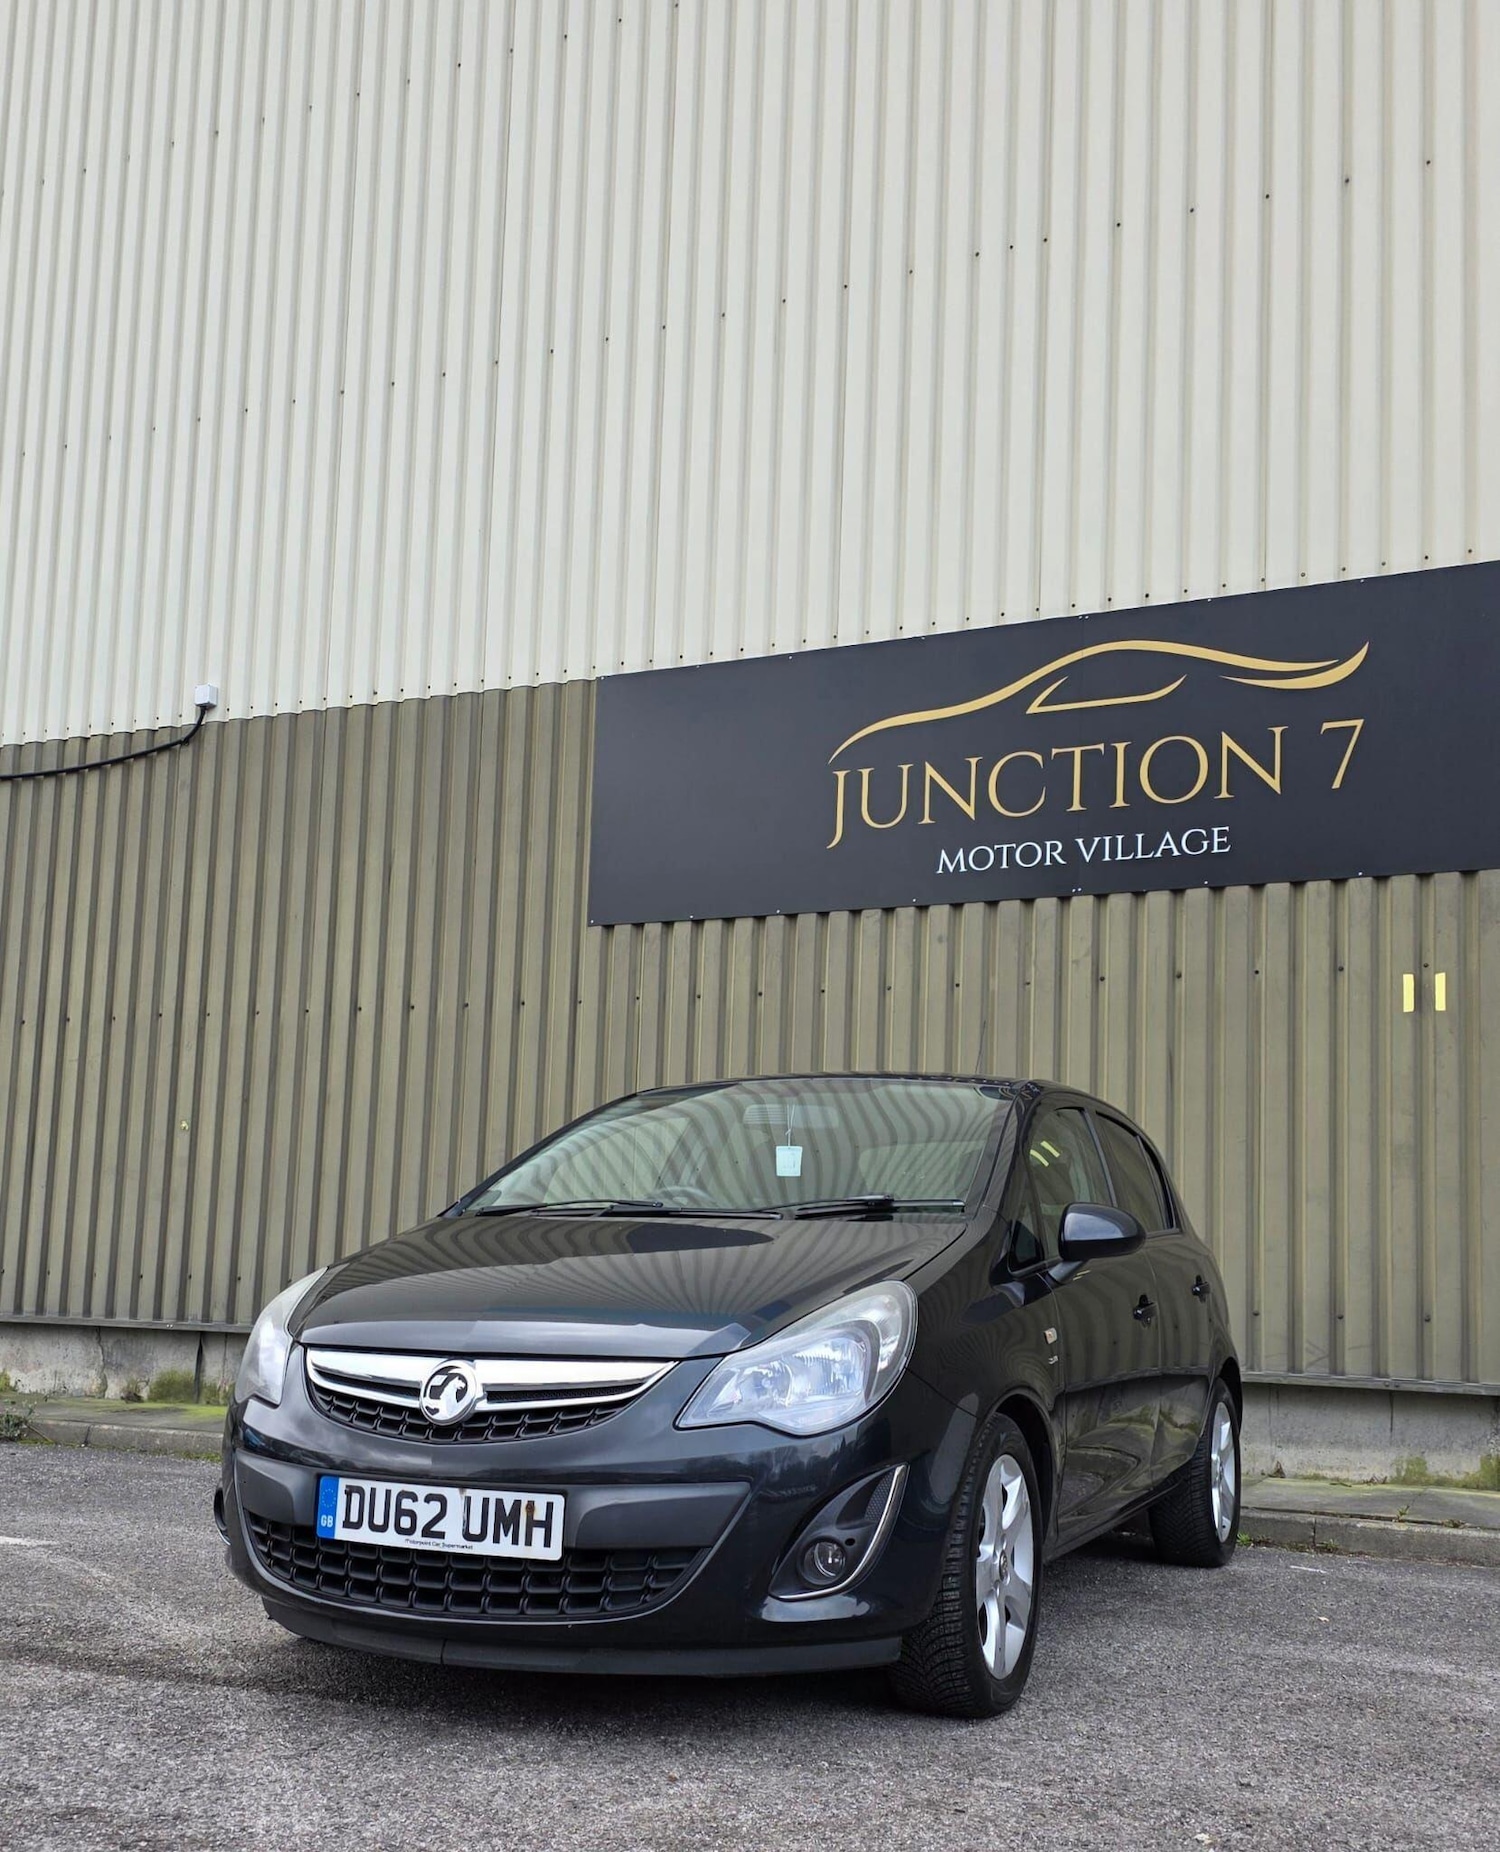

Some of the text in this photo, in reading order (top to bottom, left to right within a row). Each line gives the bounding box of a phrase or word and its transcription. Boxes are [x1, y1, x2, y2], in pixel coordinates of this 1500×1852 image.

[826, 718, 1365, 850] JUNCTION 7
[936, 826, 1231, 875] MOTOR VILLAGE
[320, 1514, 334, 1528] GB
[342, 1484, 554, 1548] DU62 UMH
